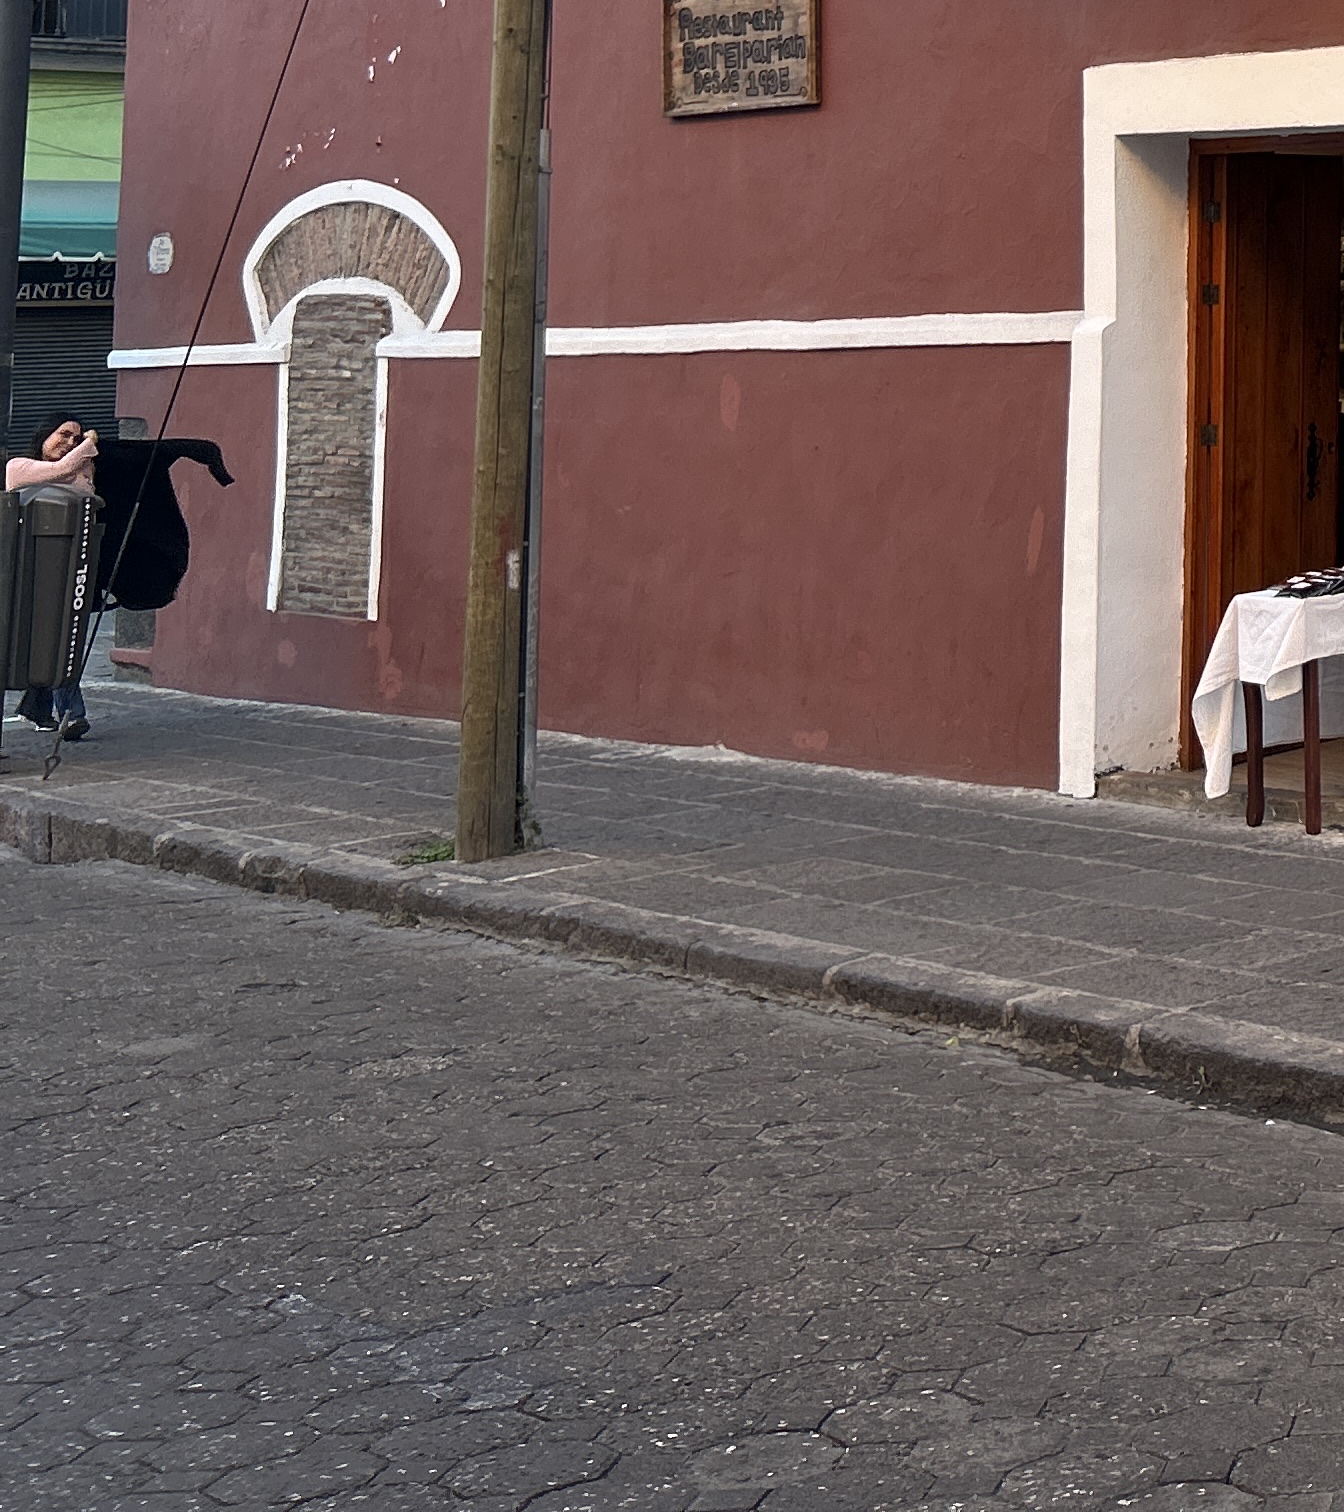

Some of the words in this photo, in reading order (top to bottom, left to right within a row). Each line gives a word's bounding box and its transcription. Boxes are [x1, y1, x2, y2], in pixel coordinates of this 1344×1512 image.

[678, 5, 784, 43] Restaurant
[682, 42, 722, 74] Bar
[745, 66, 791, 97] 1935
[16, 280, 116, 300] ANTIGU
[73, 563, 89, 611] OOSL
